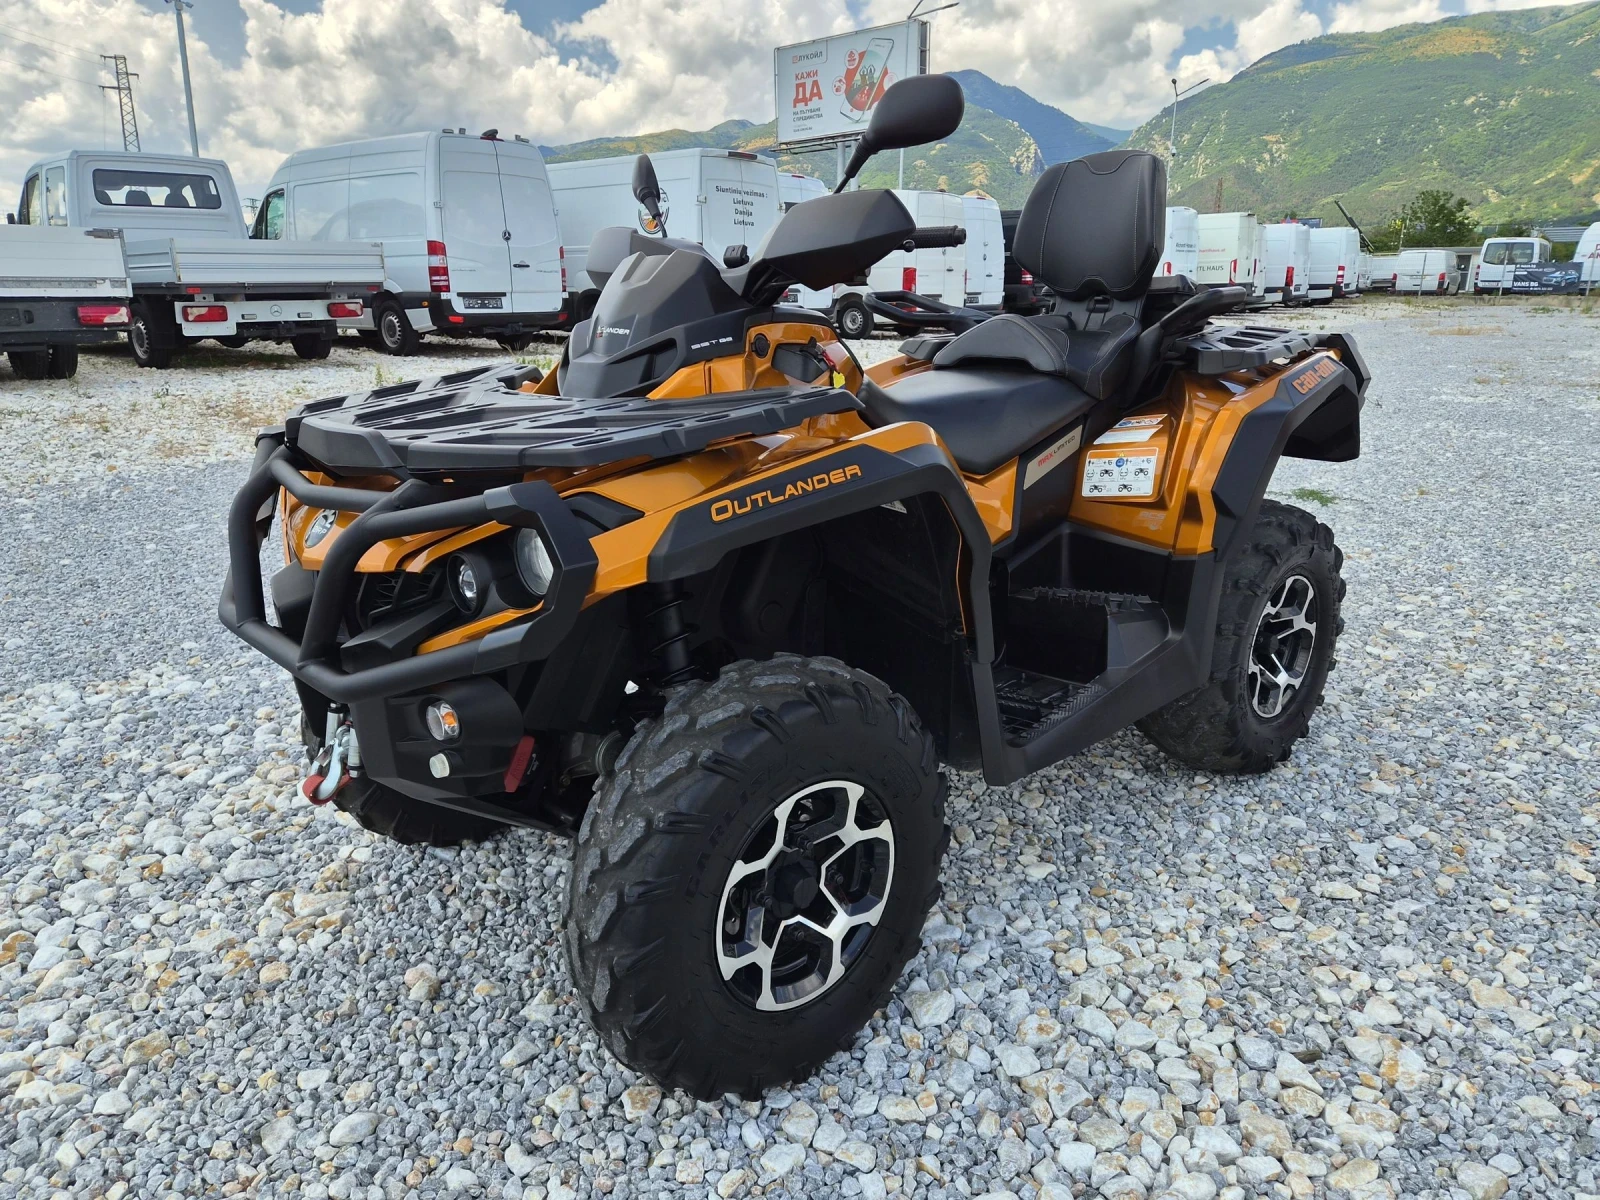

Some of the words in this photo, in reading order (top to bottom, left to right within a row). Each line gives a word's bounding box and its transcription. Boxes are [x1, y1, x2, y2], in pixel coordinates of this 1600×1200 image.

[798, 50, 823, 62] ЛУКОЙЛ
[795, 69, 819, 81] КАЖИ
[793, 79, 823, 109] ДА
[732, 198, 754, 206] Lietuva
[734, 208, 753, 217] Danija
[733, 218, 755, 226] Lietuva
[1291, 359, 1337, 394] can-am
